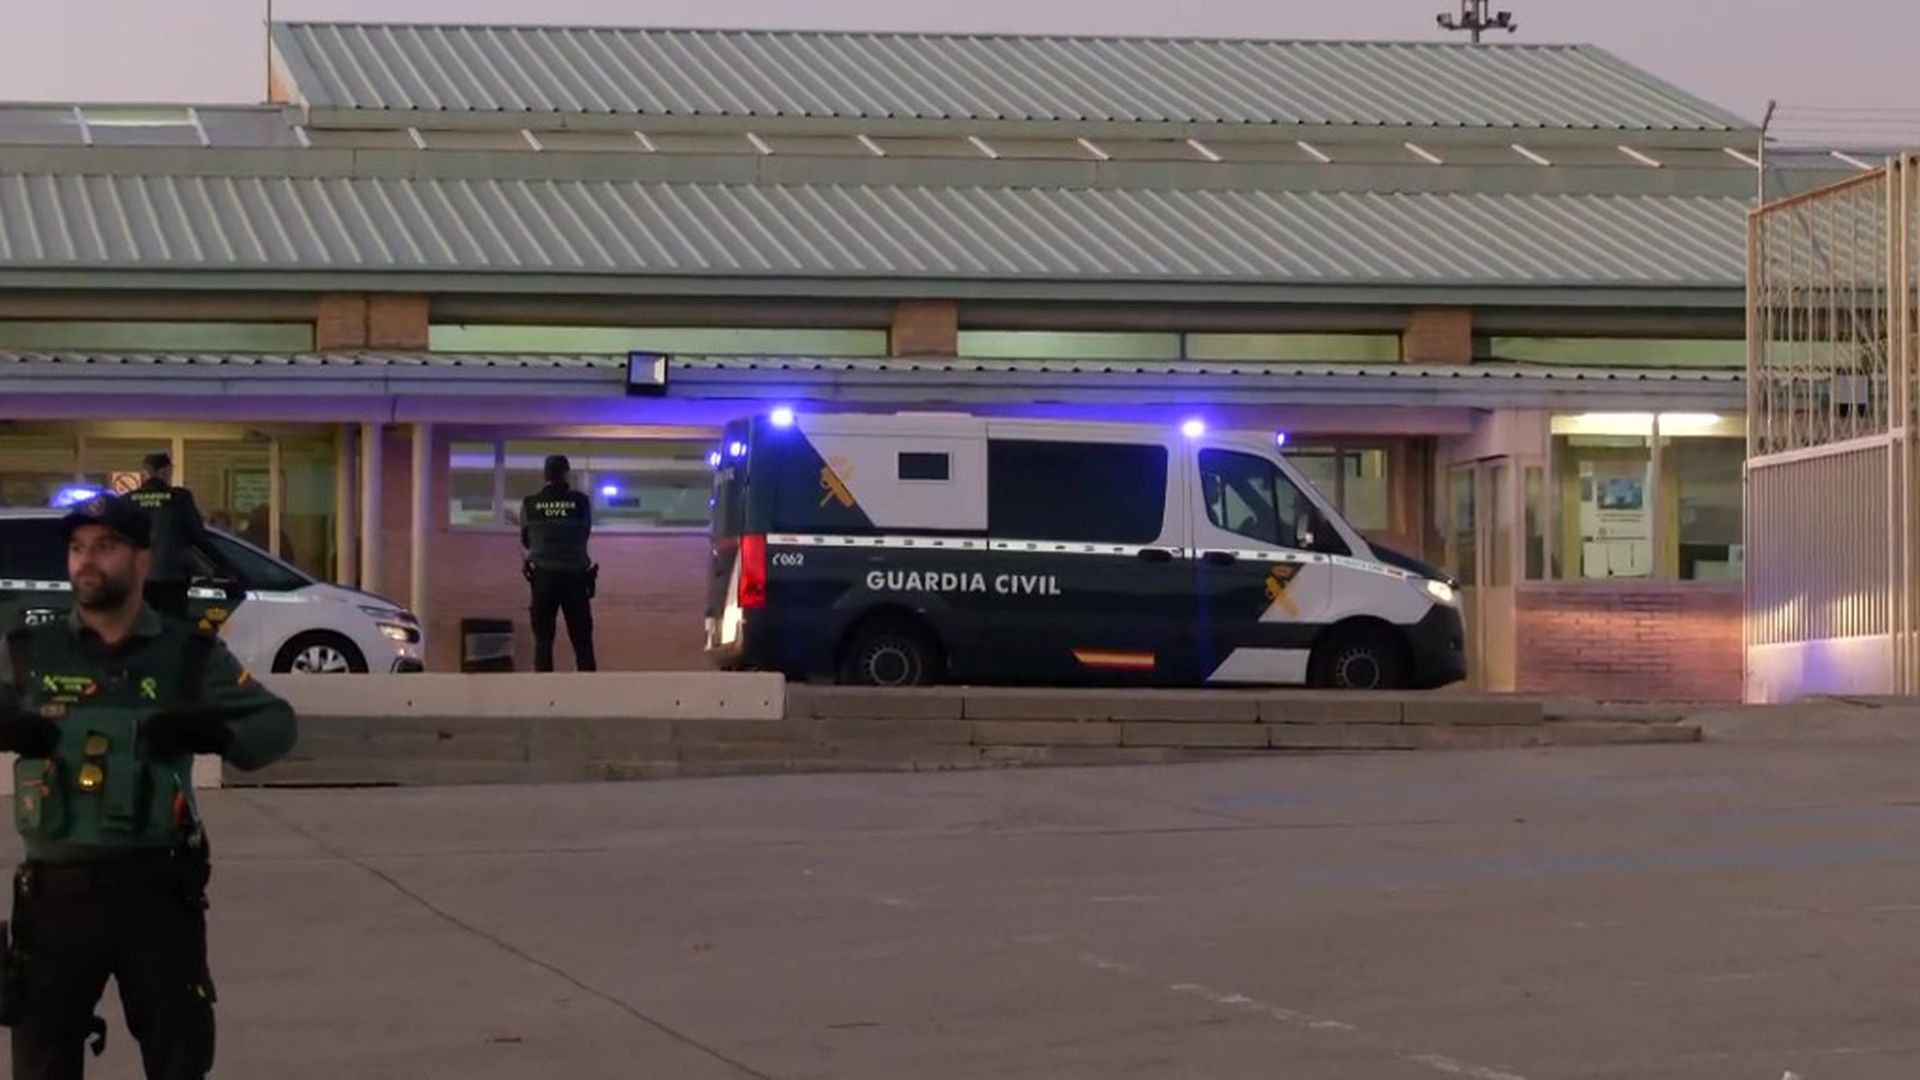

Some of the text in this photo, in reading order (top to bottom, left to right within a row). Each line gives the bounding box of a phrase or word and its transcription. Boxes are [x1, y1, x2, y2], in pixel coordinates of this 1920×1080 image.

[780, 552, 804, 566] 062
[866, 570, 1061, 595] GUARDIA CIVIL
